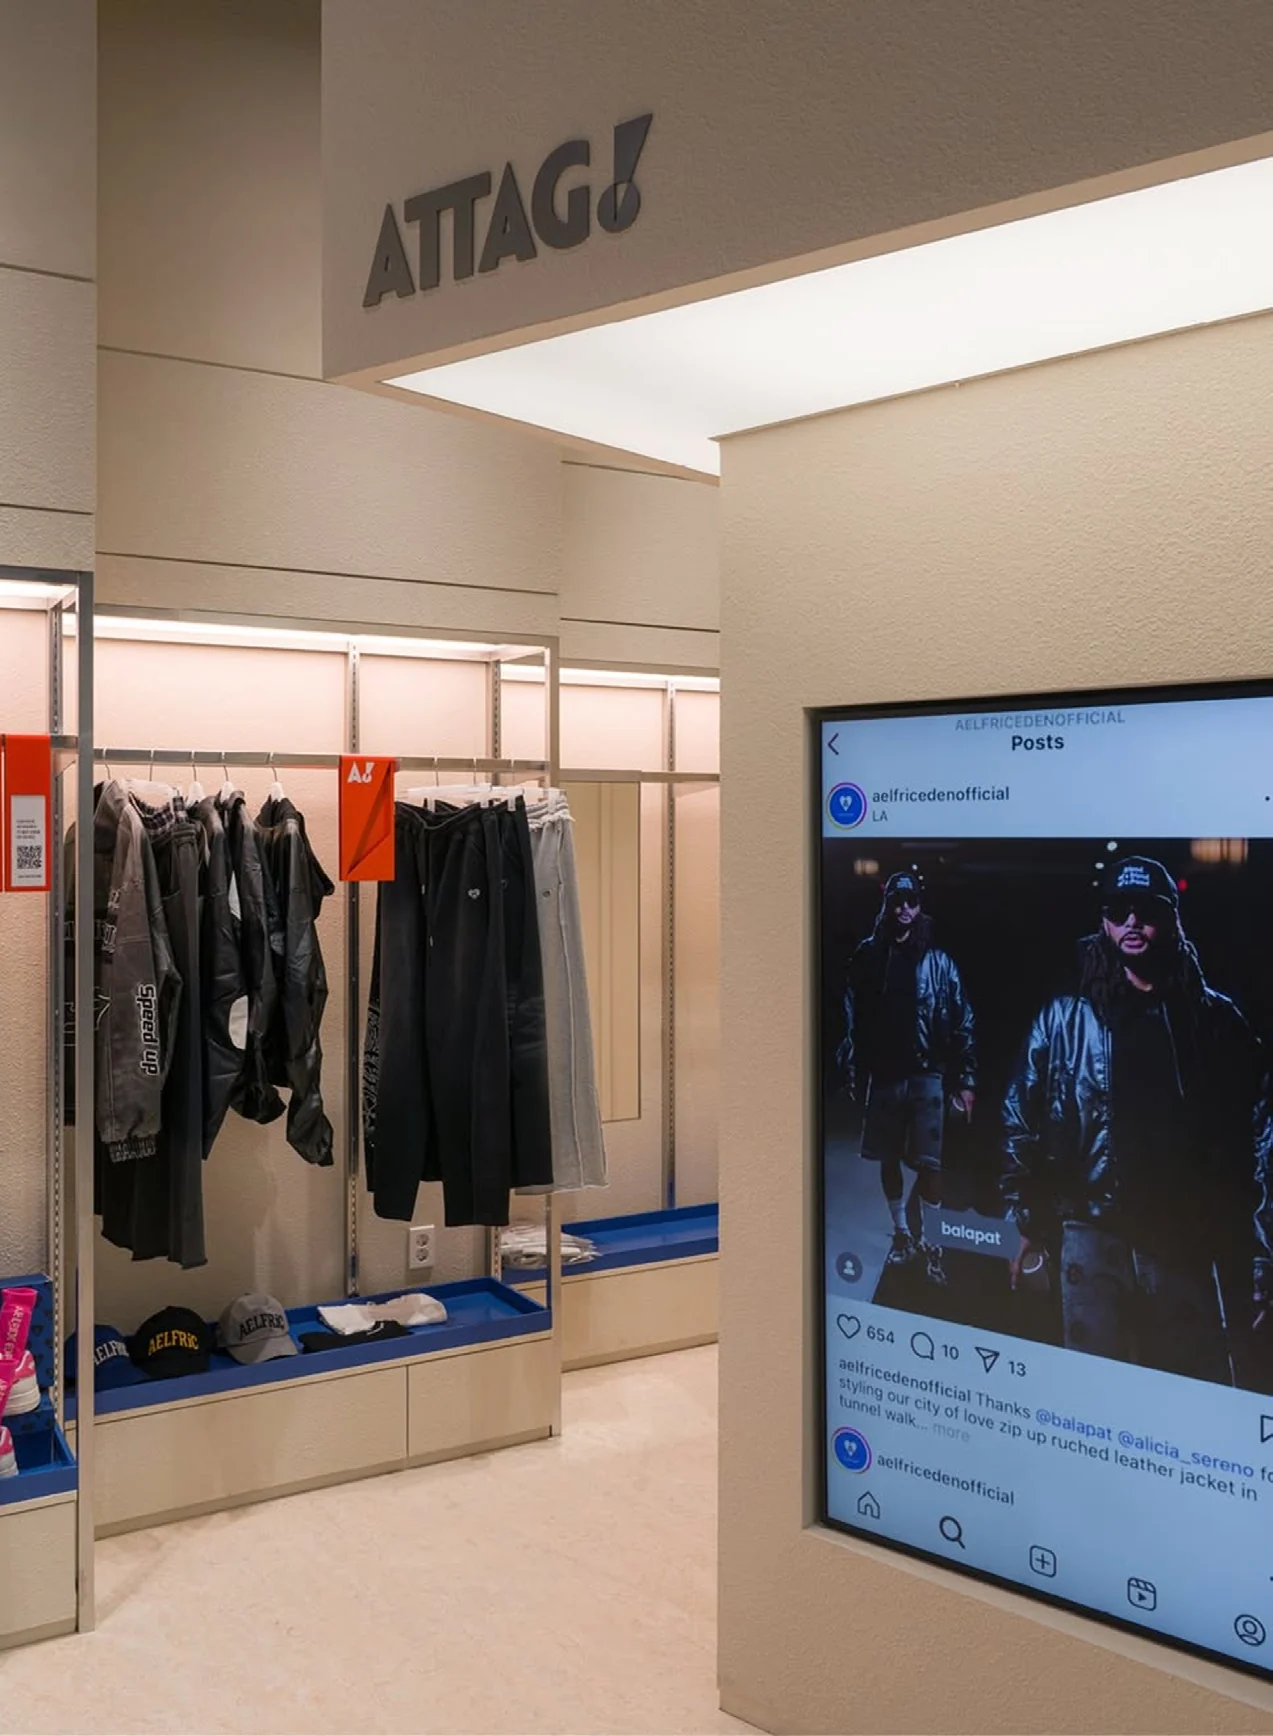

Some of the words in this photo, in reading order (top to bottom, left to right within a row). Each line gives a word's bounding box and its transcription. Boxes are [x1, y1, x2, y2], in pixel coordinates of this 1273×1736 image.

[955, 709, 1126, 732] AELFRICEDENOFFICIAL
[1011, 734, 1065, 752] Posts
[872, 785, 1010, 803] aelfricedenofficial
[872, 810, 888, 824] LA
[136, 983, 160, 1045] Speed
[140, 1049, 160, 1076] up
[941, 1221, 1002, 1245] balapat
[866, 1324, 896, 1344] 654
[942, 1343, 959, 1360] 10
[1008, 1360, 1027, 1377] 13
[839, 1358, 971, 1402] aelfricedenofficial
[976, 1391, 1031, 1420] Thanks
[1036, 1408, 1113, 1441] @balapat
[1118, 1430, 1254, 1478] @alicia_sereno
[839, 1394, 881, 1417] tunnel
[933, 1421, 971, 1443] more
[839, 1376, 883, 1401] styling
[887, 1390, 909, 1407] our
[914, 1396, 940, 1418] city
[944, 1404, 959, 1420] of
[963, 1410, 995, 1430] love
[999, 1420, 1022, 1438] zip
[1027, 1430, 1047, 1446] up
[1052, 1433, 1109, 1461] ruched
[1115, 1450, 1174, 1478] leather
[1180, 1467, 1235, 1496] jacket
[1241, 1482, 1258, 1501] in
[877, 1453, 1015, 1506] aelfricedenofficial
